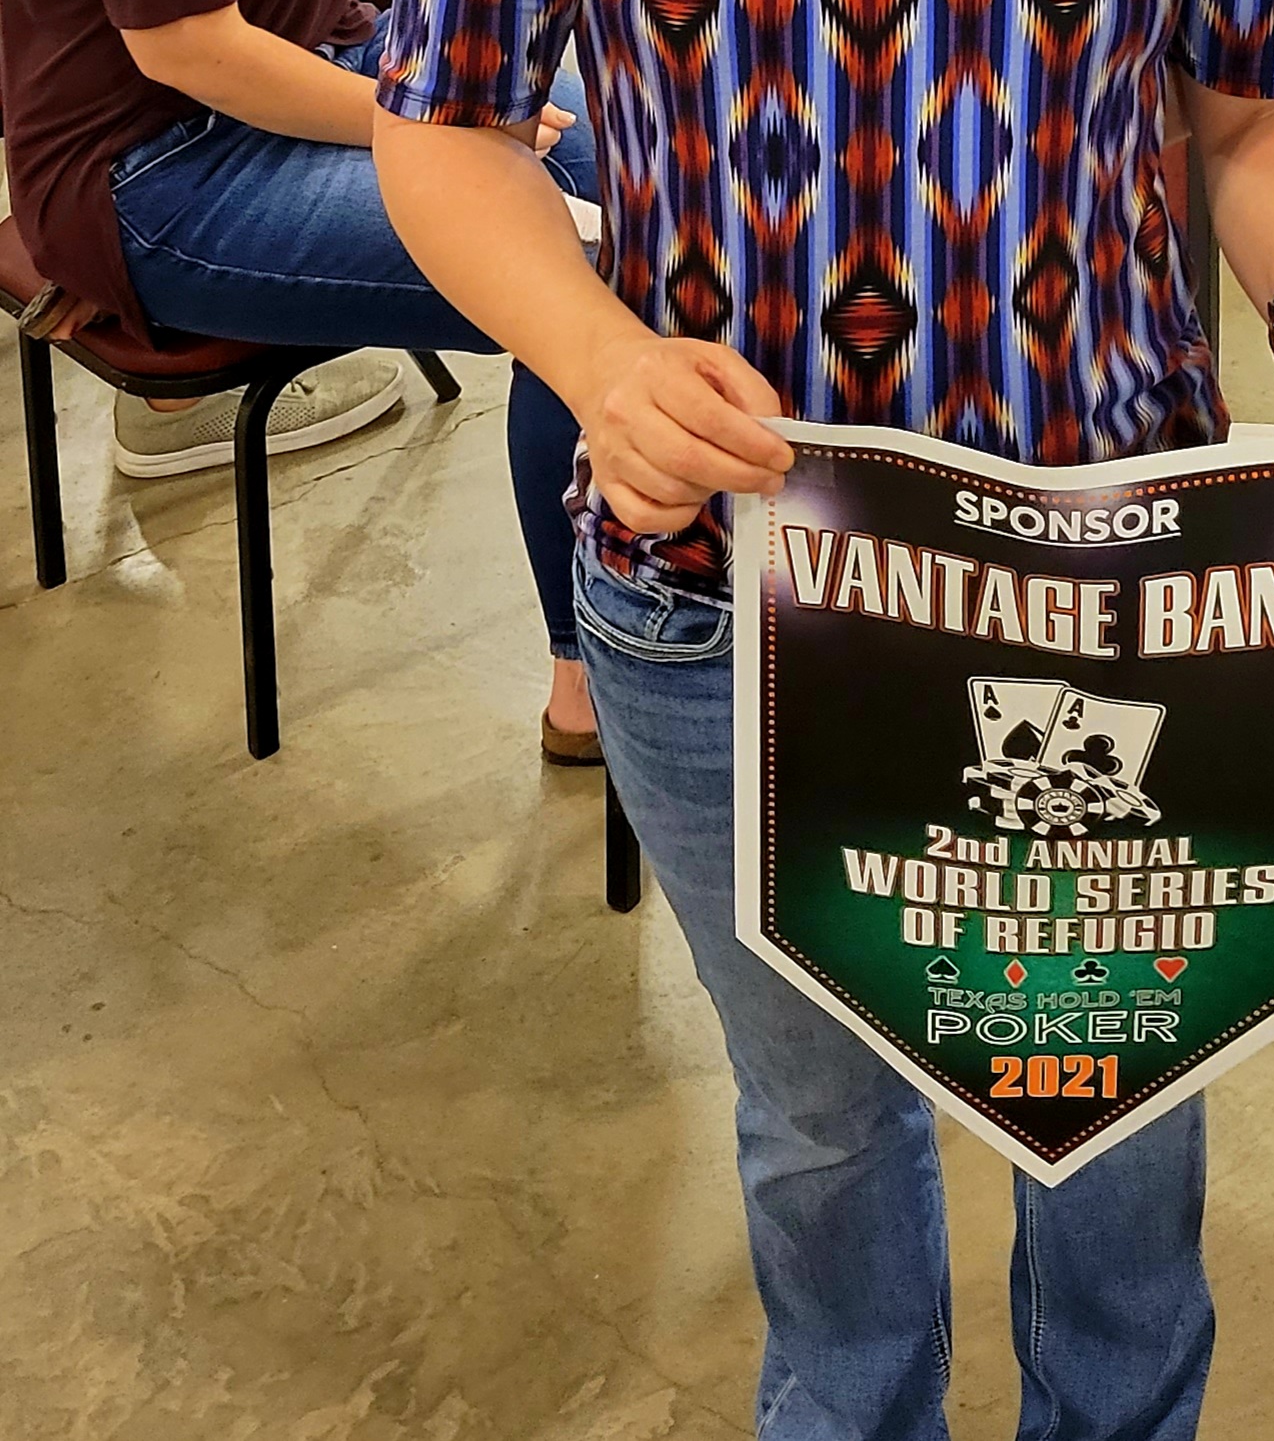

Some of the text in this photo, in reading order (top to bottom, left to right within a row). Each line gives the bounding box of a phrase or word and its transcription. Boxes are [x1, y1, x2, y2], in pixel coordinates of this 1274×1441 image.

[954, 489, 1182, 542] SPONSOR
[782, 525, 1121, 660] VANTAGE
[926, 823, 1198, 870] 2nd ANNUAL
[843, 847, 1051, 912] WORLD
[902, 907, 1216, 954] OF REFUGIO
[927, 986, 1182, 1013] TEXAS HOLD 'EM
[926, 1008, 1181, 1046] POKER
[989, 1054, 1119, 1099] 2021
